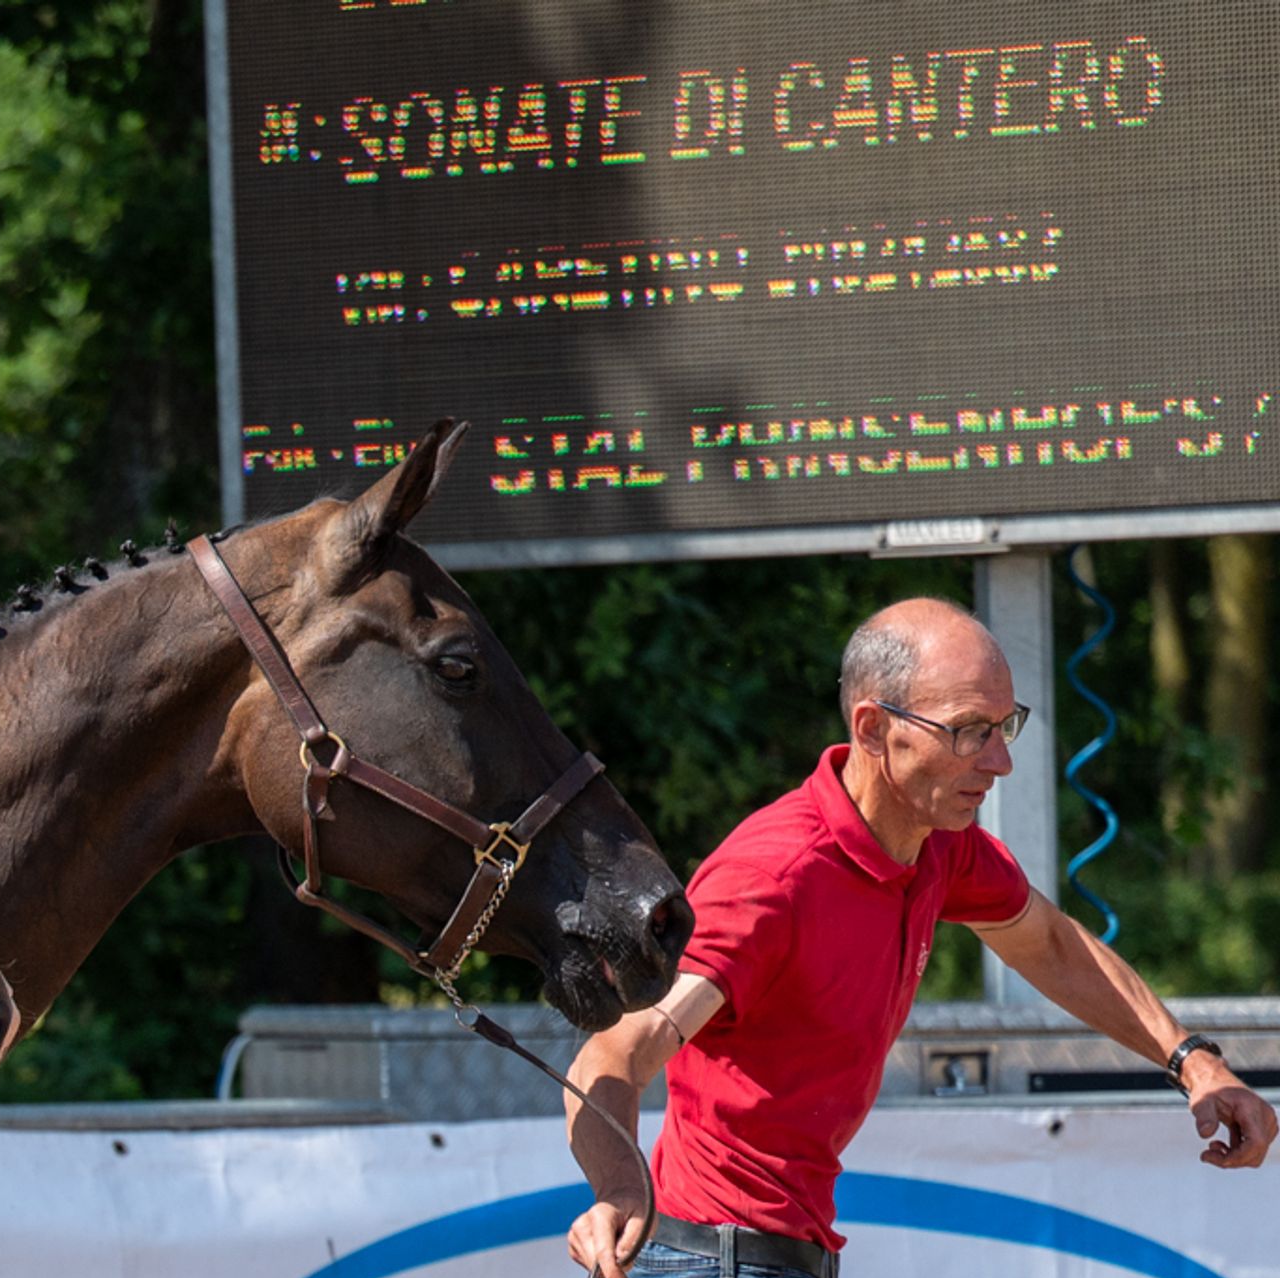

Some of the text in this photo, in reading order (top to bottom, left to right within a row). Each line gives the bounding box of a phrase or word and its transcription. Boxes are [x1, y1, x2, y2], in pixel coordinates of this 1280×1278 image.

[338, 76, 648, 184] SONATE
[669, 66, 747, 160] DI
[772, 36, 1166, 150] CANTERO
